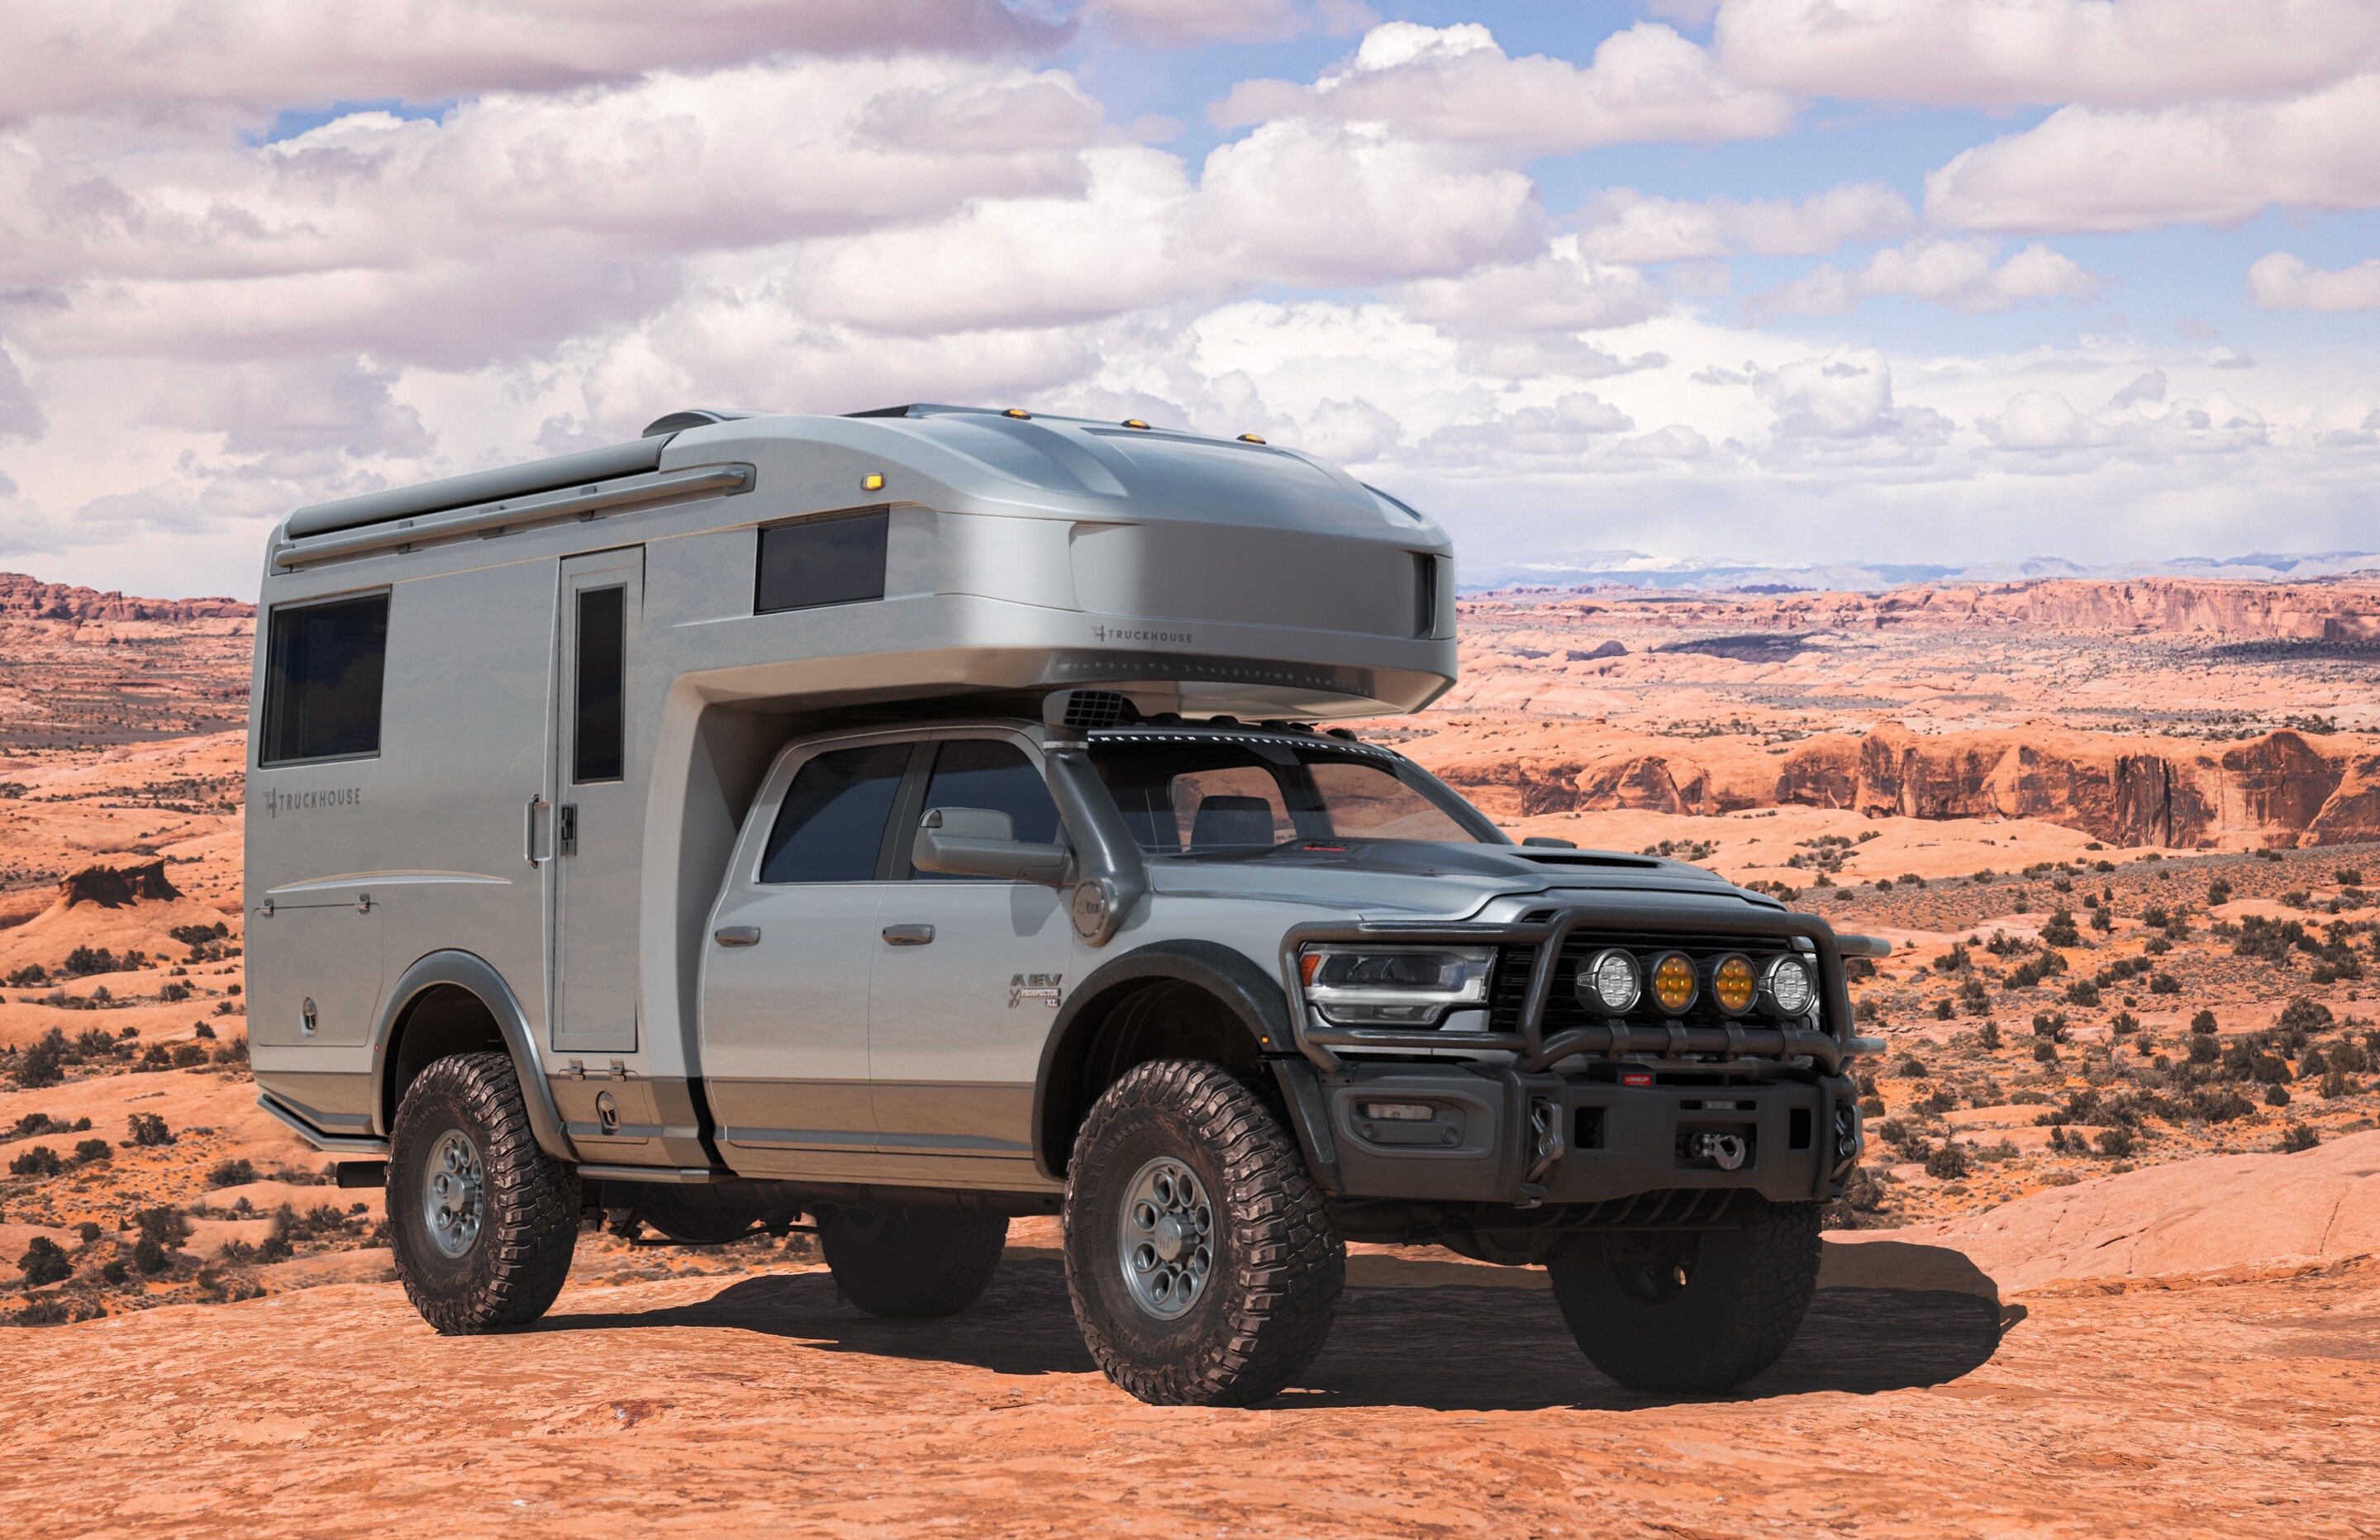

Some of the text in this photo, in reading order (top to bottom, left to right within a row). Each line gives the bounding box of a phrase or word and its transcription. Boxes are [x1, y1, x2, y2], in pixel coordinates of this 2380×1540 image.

[1108, 630, 1192, 643] TRUCKHOUSE
[279, 787, 360, 810] TRUCKHOUSE
[1010, 973, 1062, 986] AEV
